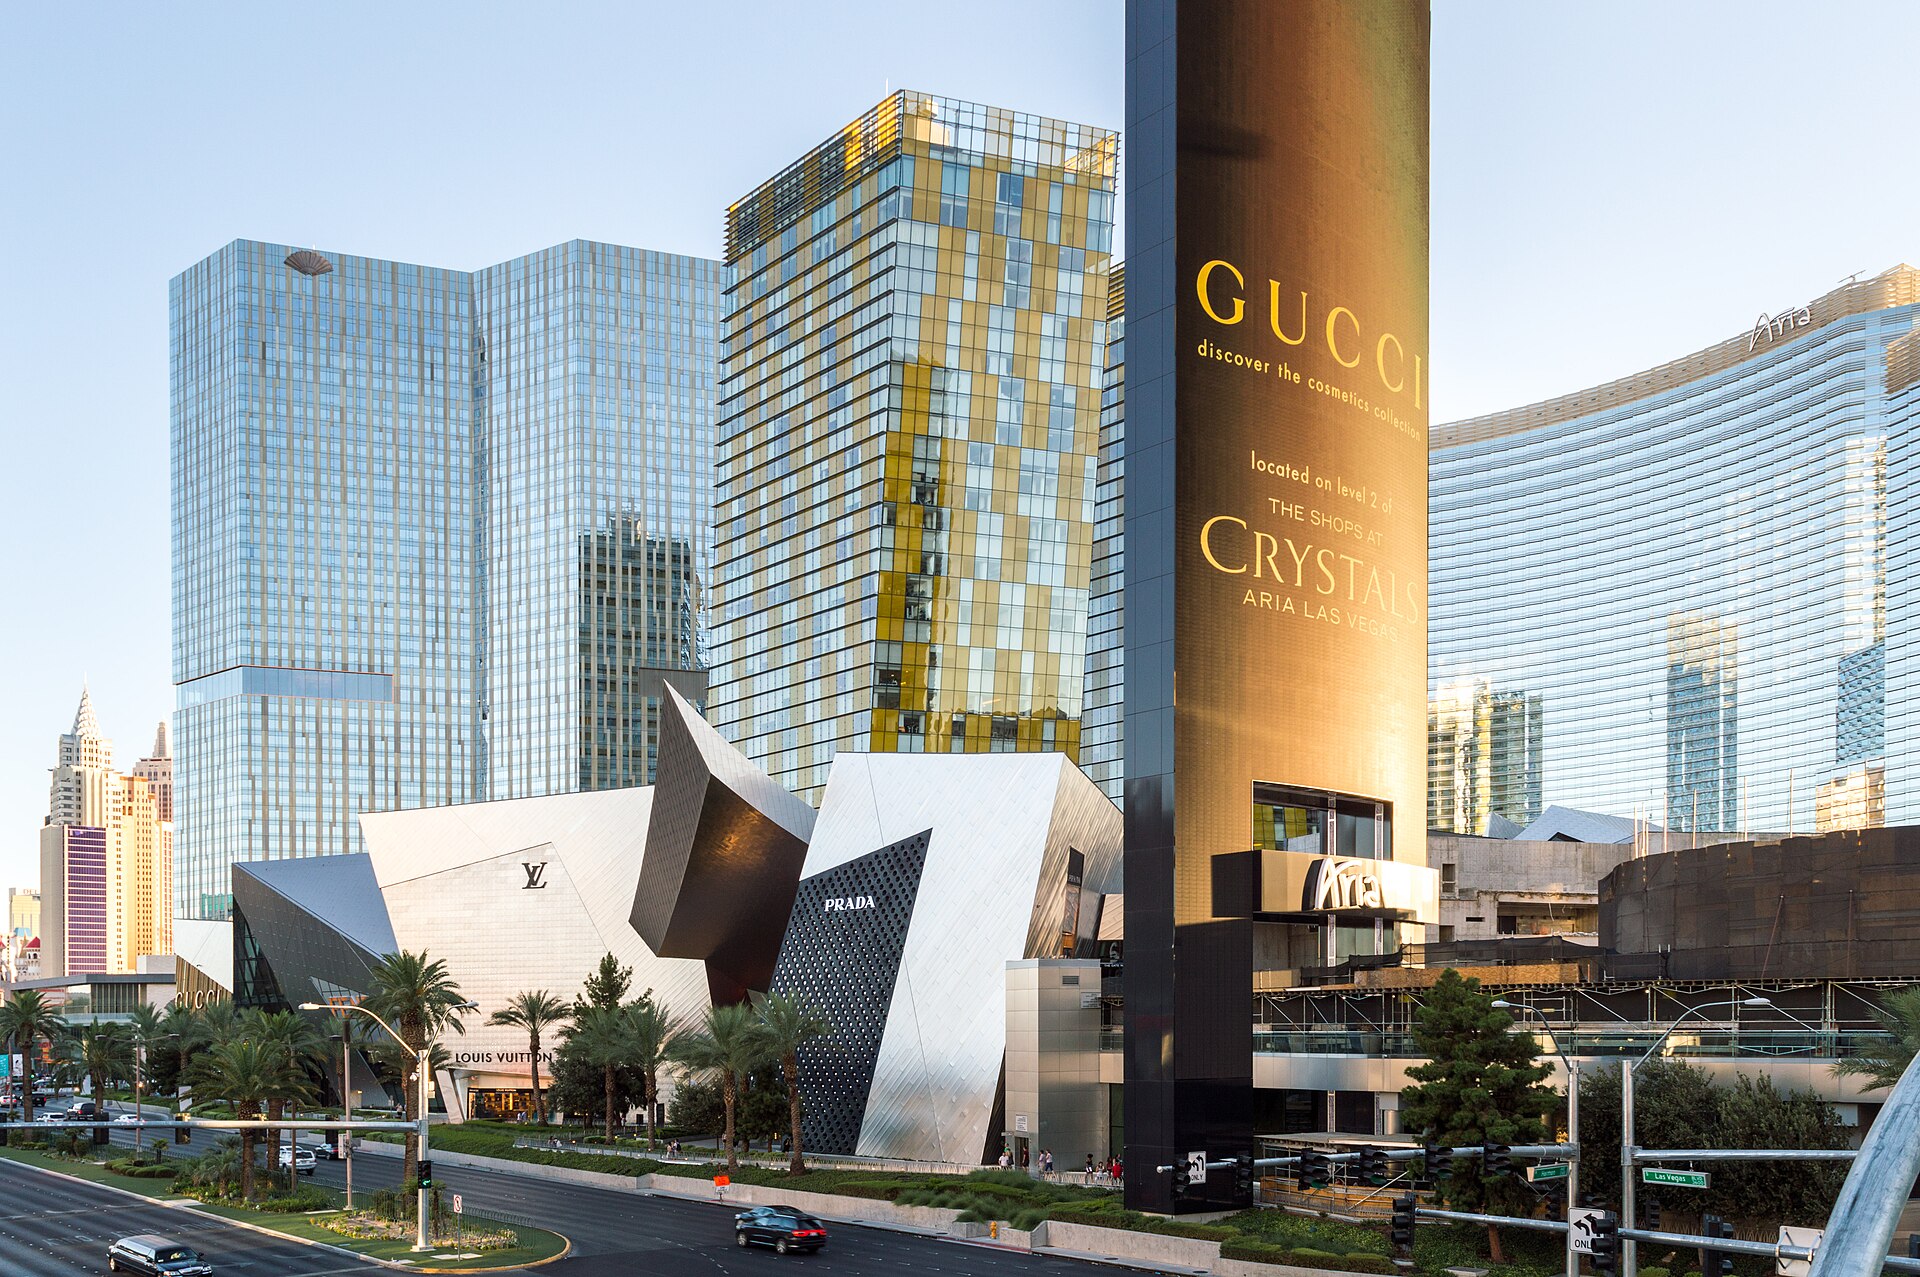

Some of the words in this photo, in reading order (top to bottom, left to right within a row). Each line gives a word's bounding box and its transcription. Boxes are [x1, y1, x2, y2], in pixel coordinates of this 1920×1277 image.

[1197, 260, 1421, 409] GUCCI
[1749, 306, 1811, 352] Aria
[1198, 339, 1270, 373] discover
[1278, 362, 1301, 384] the
[1308, 377, 1370, 412] cosmetics
[1374, 406, 1421, 442] collection
[1251, 450, 1309, 484] located
[1315, 476, 1332, 492] on
[1338, 476, 1366, 504] level
[1371, 492, 1378, 509] 2
[1382, 497, 1393, 515] of
[1268, 497, 1305, 522] THE
[1310, 509, 1364, 540] SHOPS
[1367, 531, 1384, 548] AT
[1200, 515, 1419, 624] CRYSTALS
[1243, 589, 1296, 614] ARIA
[1304, 601, 1341, 625] LAS
[1347, 611, 1398, 642] VEGAS
[824, 895, 876, 912] PRADA
[1315, 858, 1382, 909] Aria
[455, 1052, 492, 1063] LOUIS
[1666, 1174, 1686, 1183] Vegas
[1574, 1239, 1592, 1249] ONL
